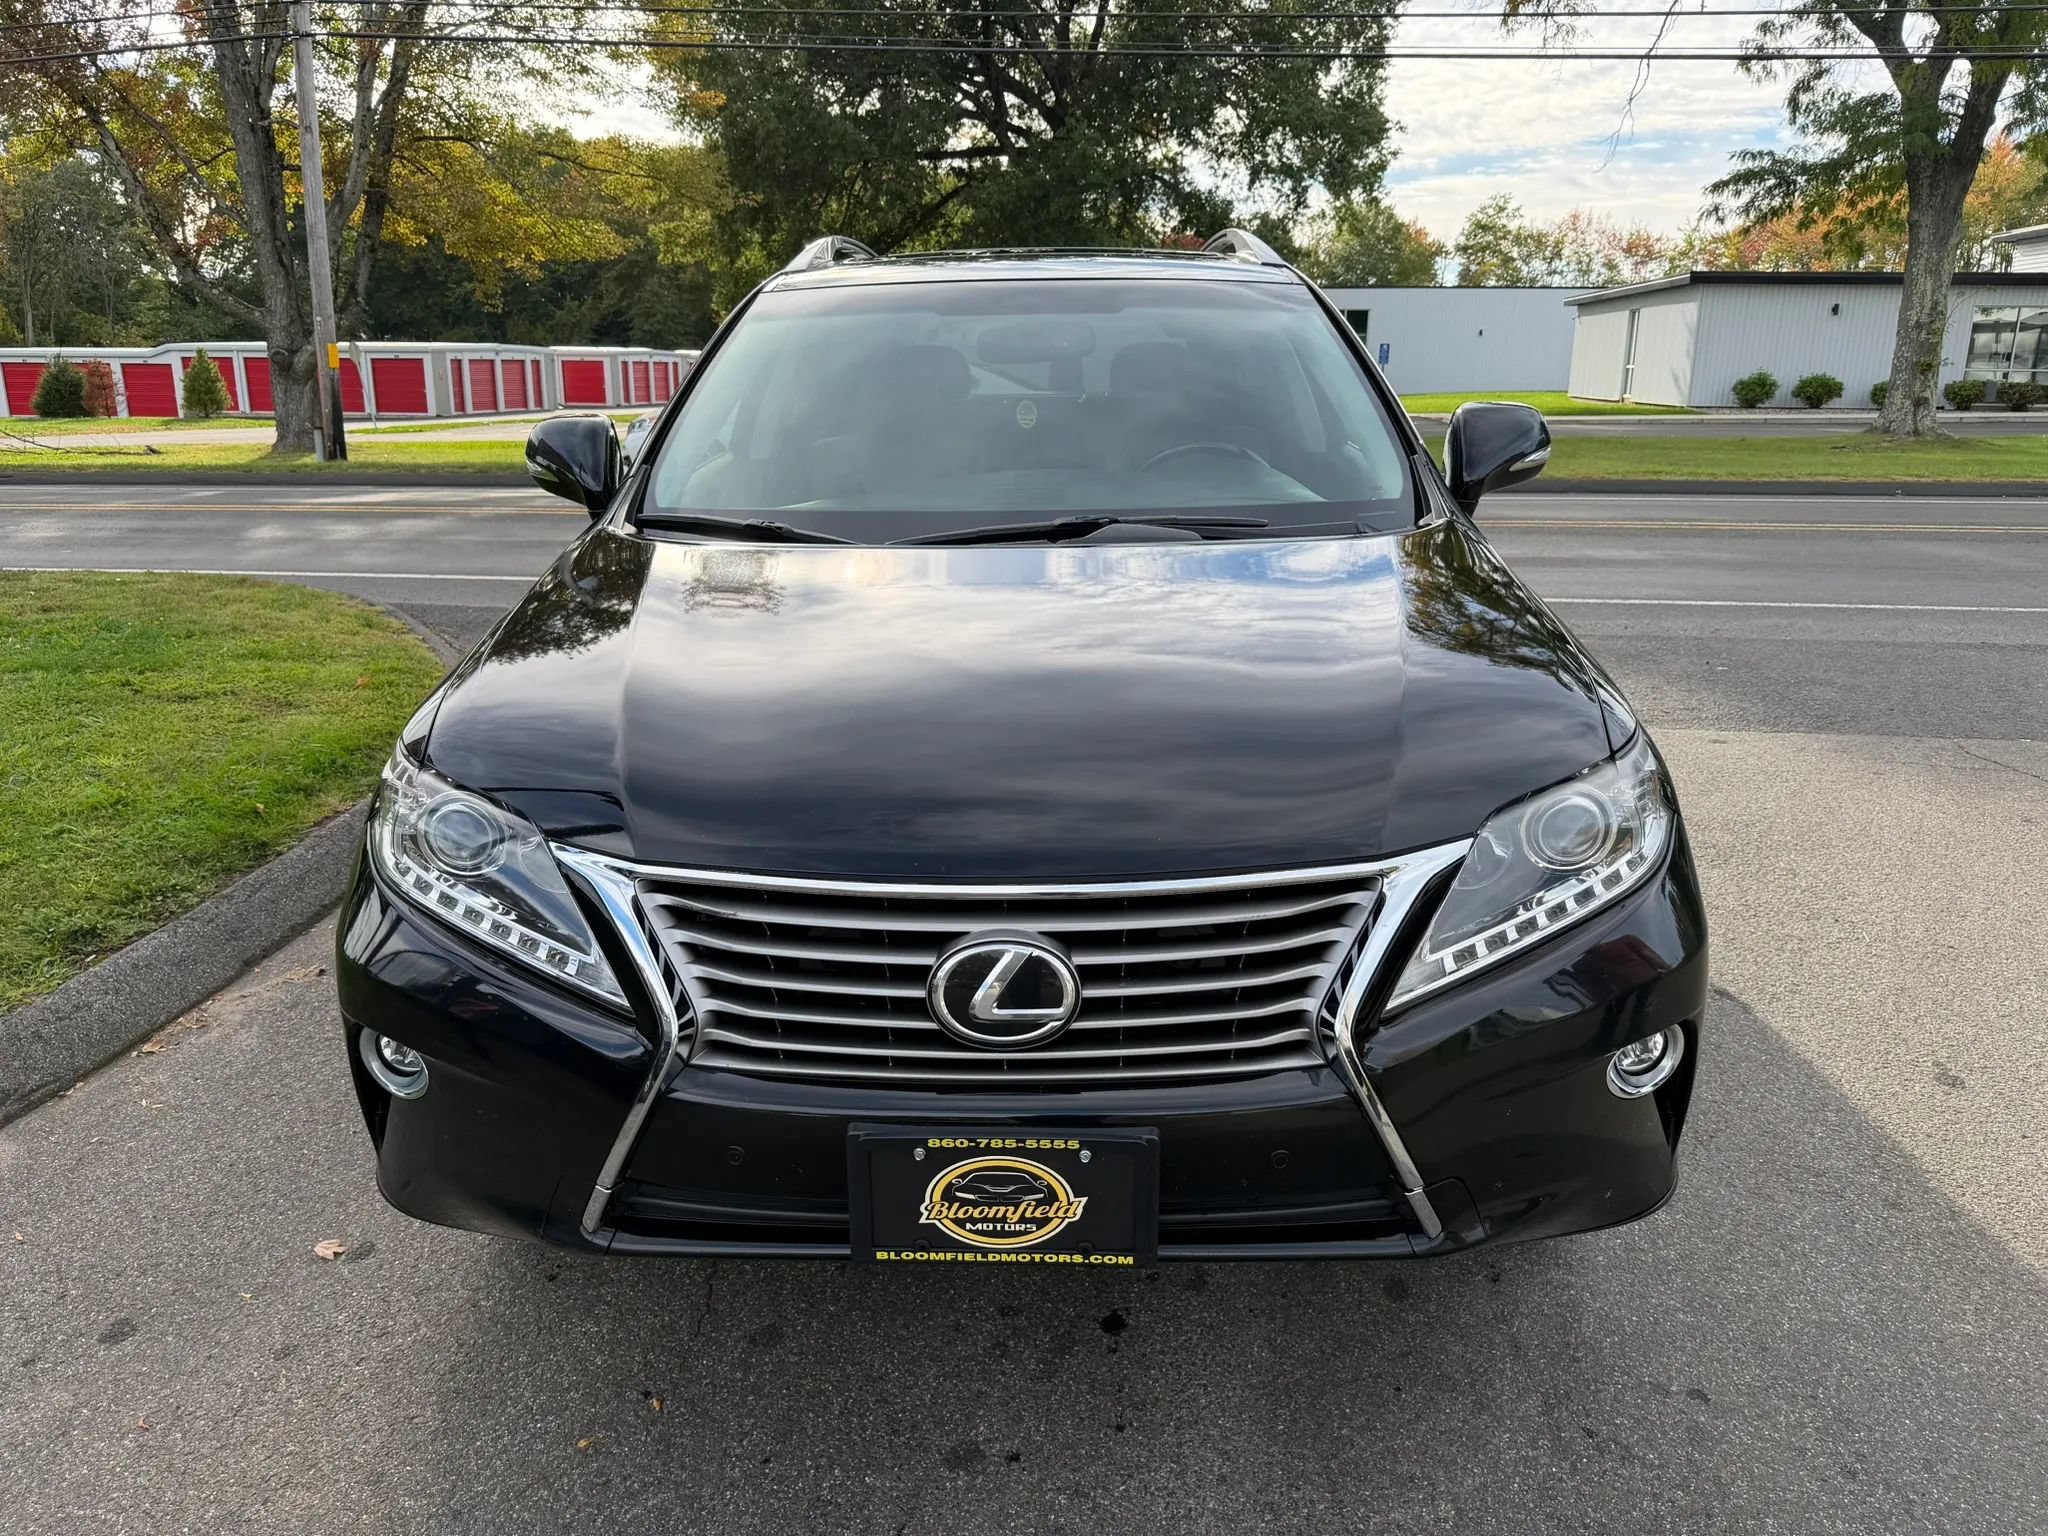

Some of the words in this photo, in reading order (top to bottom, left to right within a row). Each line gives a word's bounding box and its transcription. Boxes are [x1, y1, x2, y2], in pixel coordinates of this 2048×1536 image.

[927, 1138, 1081, 1150] 860-785-5555
[926, 1200, 1082, 1224] Bloomfield
[965, 1222, 1038, 1232] MOTORS
[875, 1251, 1135, 1266] BLOOMFIELDMOTORS.COM
